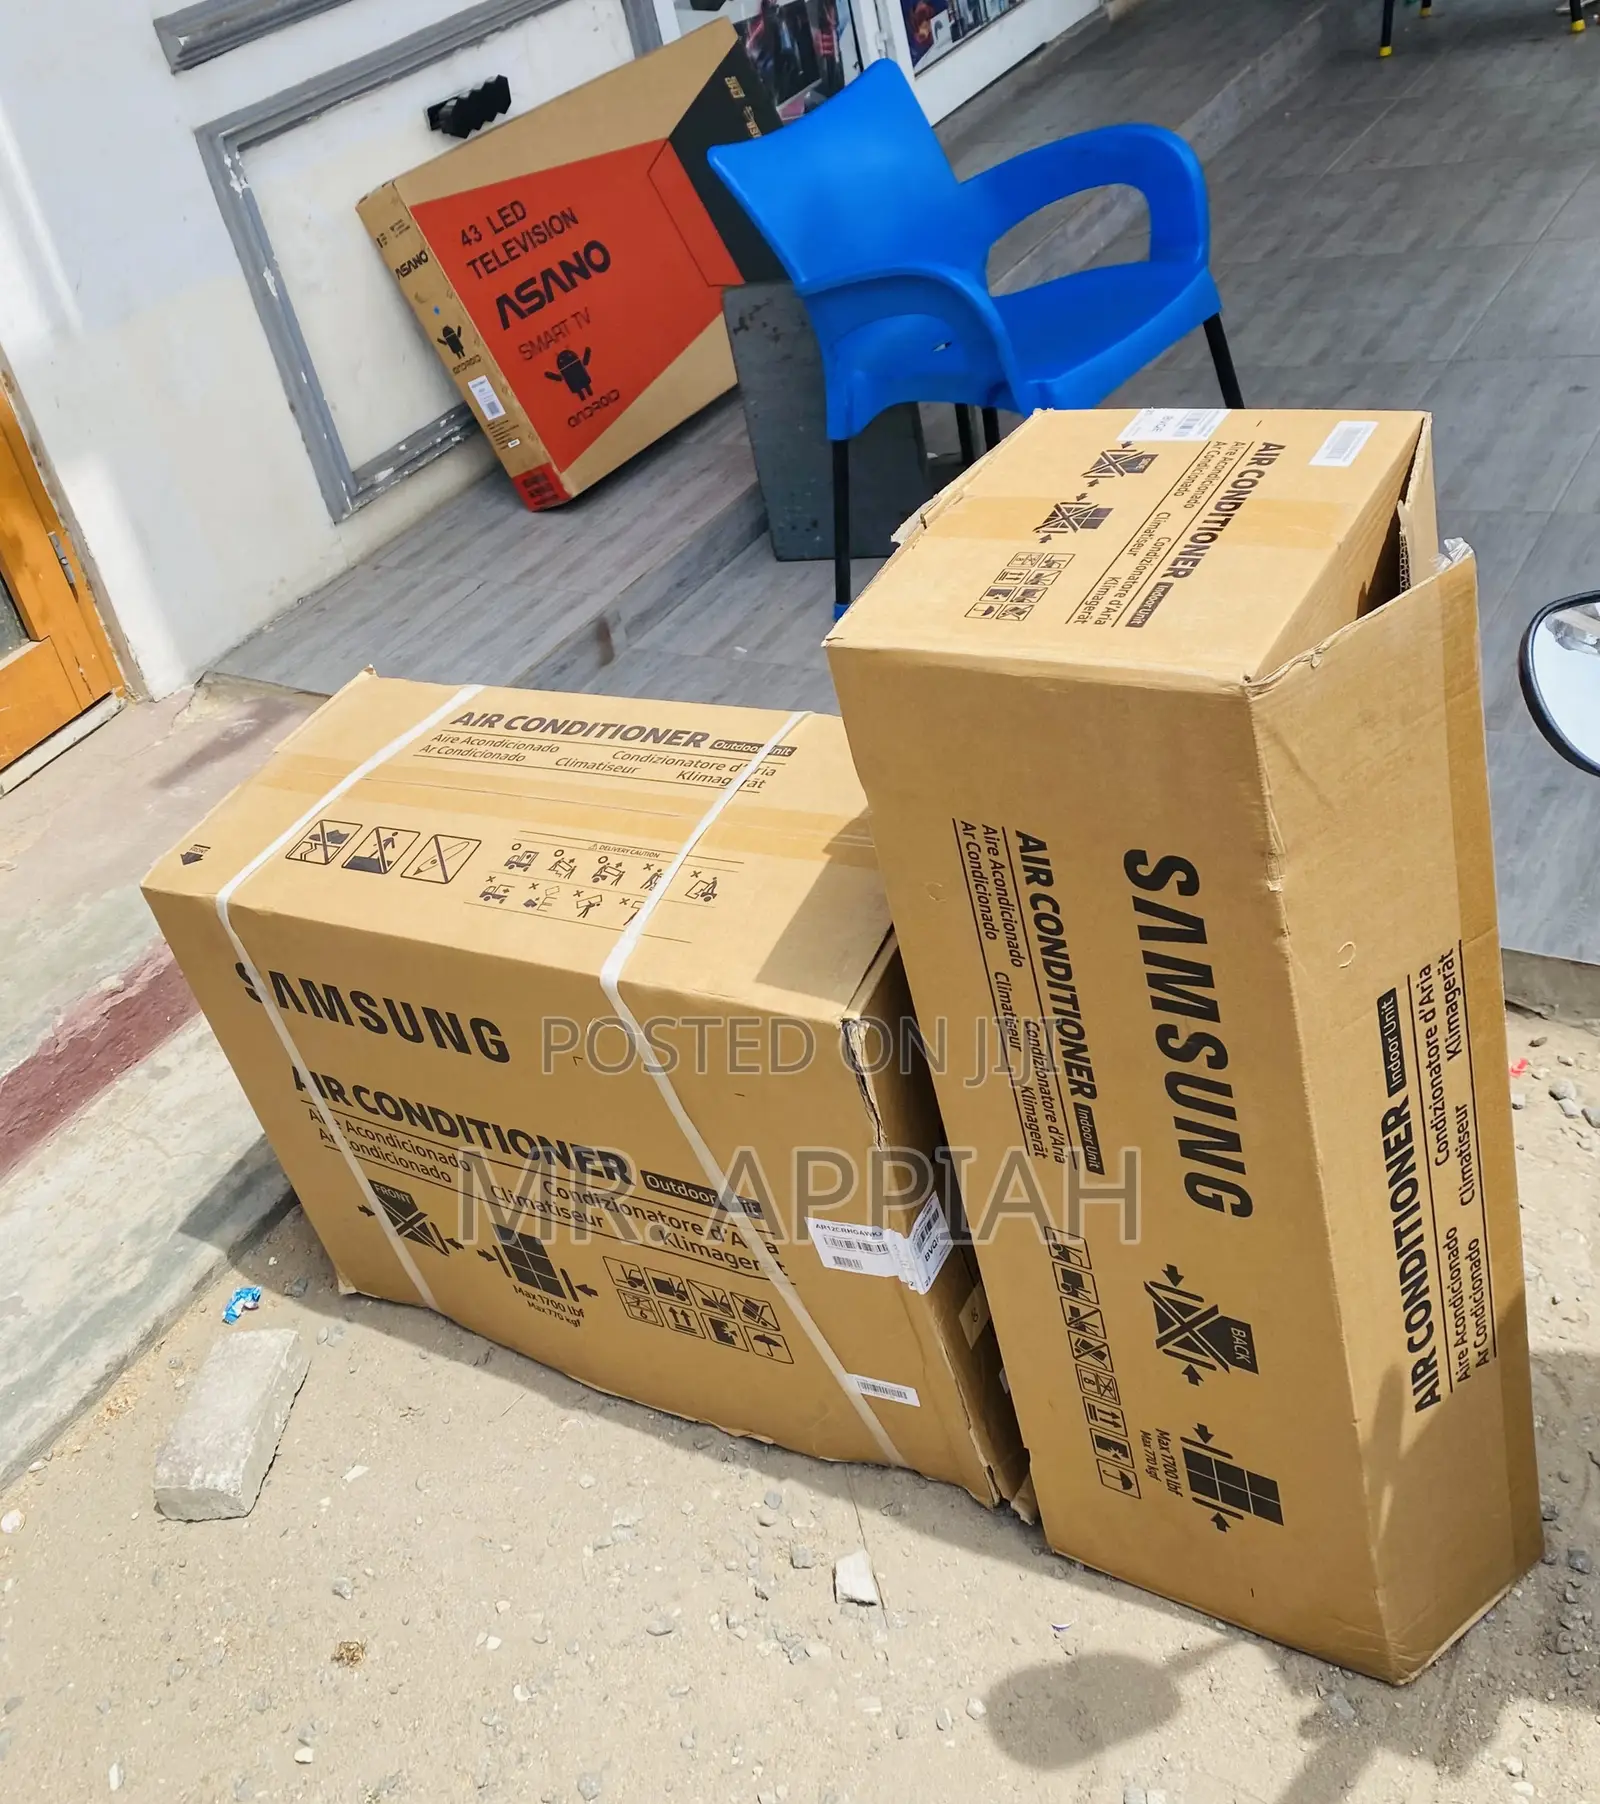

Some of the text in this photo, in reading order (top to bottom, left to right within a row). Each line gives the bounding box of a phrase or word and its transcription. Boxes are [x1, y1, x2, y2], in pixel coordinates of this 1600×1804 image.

[460, 200, 527, 247] 43 LED
[466, 207, 579, 280] TELEVISION
[394, 250, 429, 280] ASANO
[496, 240, 611, 331] ASANO
[518, 307, 592, 361] SMART TV
[1213, 441, 1228, 450] Ar
[1225, 441, 1246, 456] Aire
[1245, 441, 1286, 467] AIR
[1173, 450, 1221, 497] Condicionado
[1183, 456, 1234, 509] Acondicionado
[1126, 511, 1171, 556] Climatiseur
[1160, 469, 1265, 579] CONDITIONER
[1114, 537, 1172, 598] Condizionatore
[1073, 576, 1122, 625] Klimagerät
[1093, 600, 1124, 626] d'Aria
[1130, 607, 1152, 625] Unit
[1143, 584, 1168, 608] Indoor
[431, 733, 777, 777] Aire Acondicionado Condizionatore d'ria
[450, 711, 504, 729] AIR
[504, 716, 710, 750] CONDITIONER
[419, 744, 766, 788] Ar Condicionado Climatiseur Klimagrät
[599, 844, 660, 858] DELIVERY CAUTION
[960, 821, 1047, 1159] Ar Condicionado Climatiseur Klimagerät
[982, 824, 1068, 1165] Aire Acondicionado Condizionatore d'Aria
[1015, 830, 1101, 1169] AIR CONDITIONER Indoor Unit
[1123, 848, 1253, 1218] SAMSUNG
[352, 1085, 636, 1187] CONDITIONER
[645, 1174, 716, 1205] Outdoor
[1437, 947, 1490, 1368] Ar Condicionado Climatiseur Klimagerät
[345, 1120, 471, 1173] Acondicionado
[543, 1180, 704, 1236] Condizionatore
[374, 1183, 412, 1204] FRONT
[1416, 963, 1471, 1383] Aire Acondicionado Condizionatore d'Aria
[344, 1136, 452, 1184] ondicionado
[491, 1184, 604, 1229] Climatiseur
[658, 1229, 789, 1277] Klimagert
[1381, 996, 1441, 1413] AIR CONDITIONER Indoor Unit
[512, 1284, 585, 1318] Max 1700 lbf
[526, 1300, 548, 1315] Max
[547, 1309, 565, 1321] 770
[1230, 1326, 1251, 1364] BACK
[1140, 1429, 1162, 1482] Max 770 kgf
[1155, 1428, 1183, 1497] Max 1700 lbf
